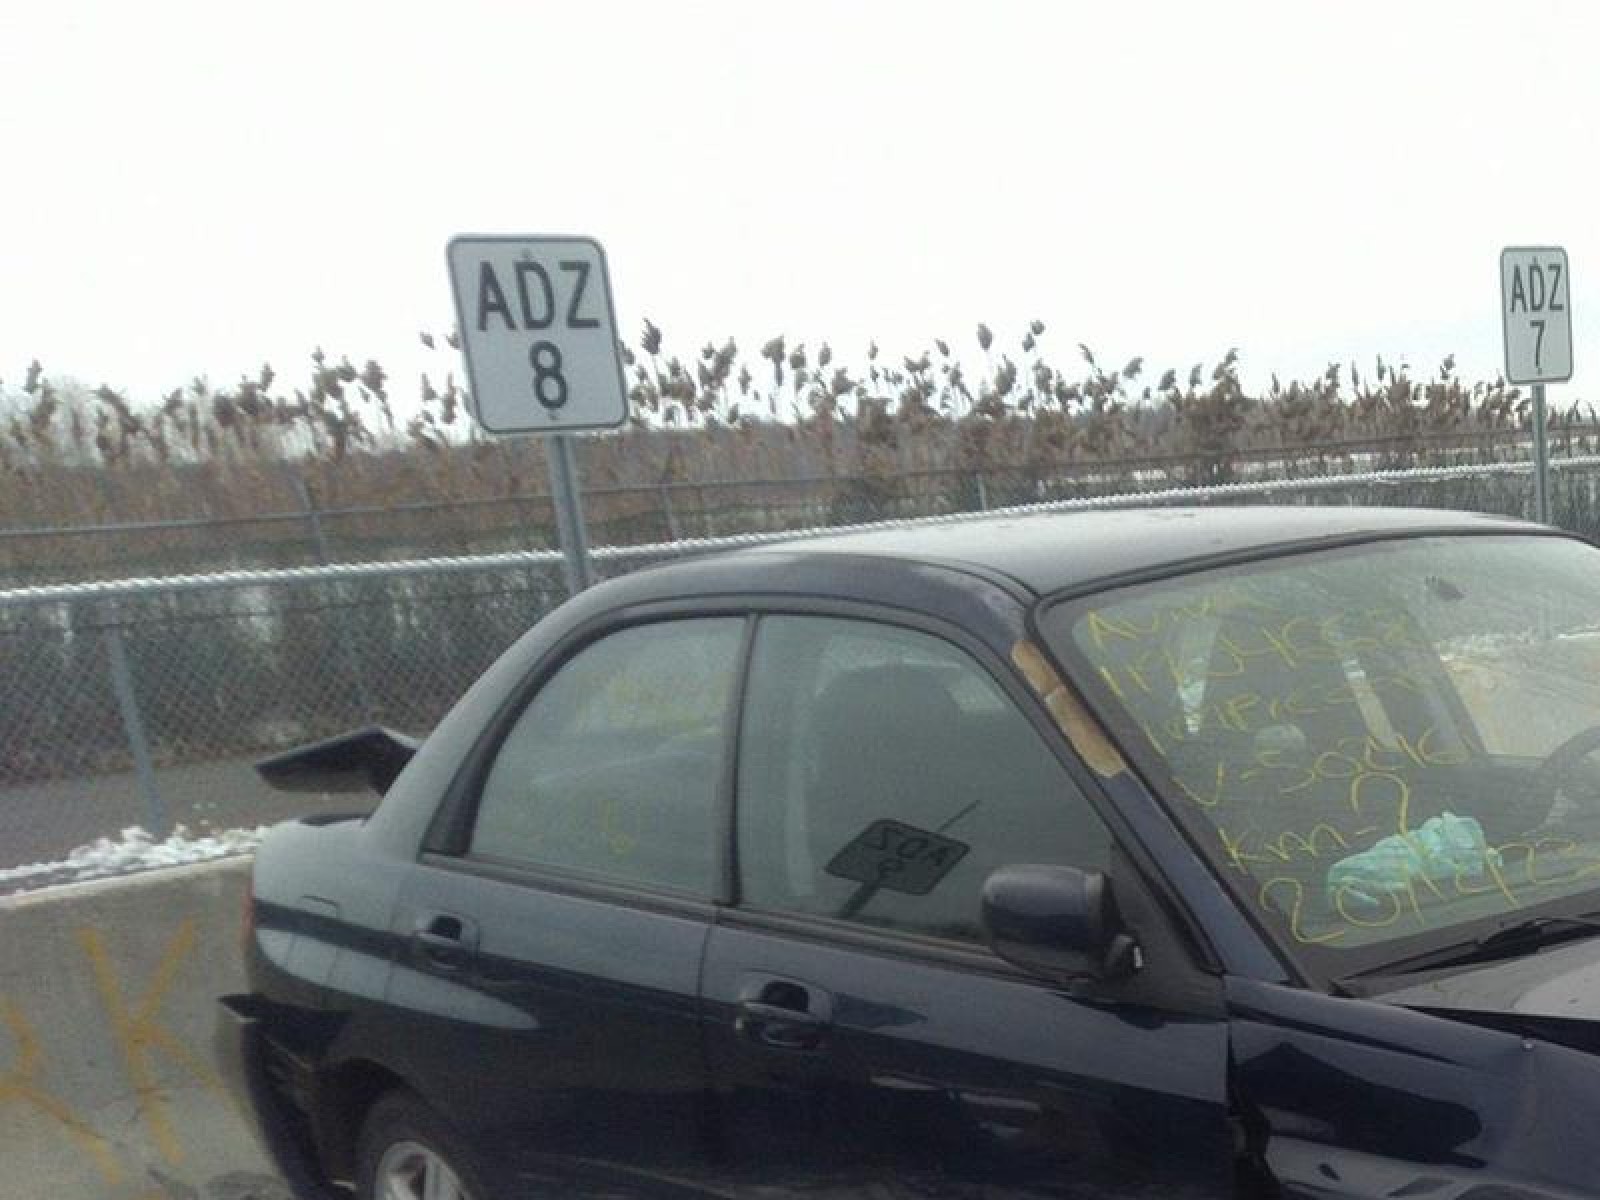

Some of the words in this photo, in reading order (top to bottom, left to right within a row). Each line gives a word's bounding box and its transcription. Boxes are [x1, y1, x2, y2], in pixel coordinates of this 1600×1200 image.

[477, 259, 600, 332] ADZ
[1509, 263, 1564, 312] ADZ
[1529, 319, 1545, 368] 7
[529, 340, 568, 409] 8
